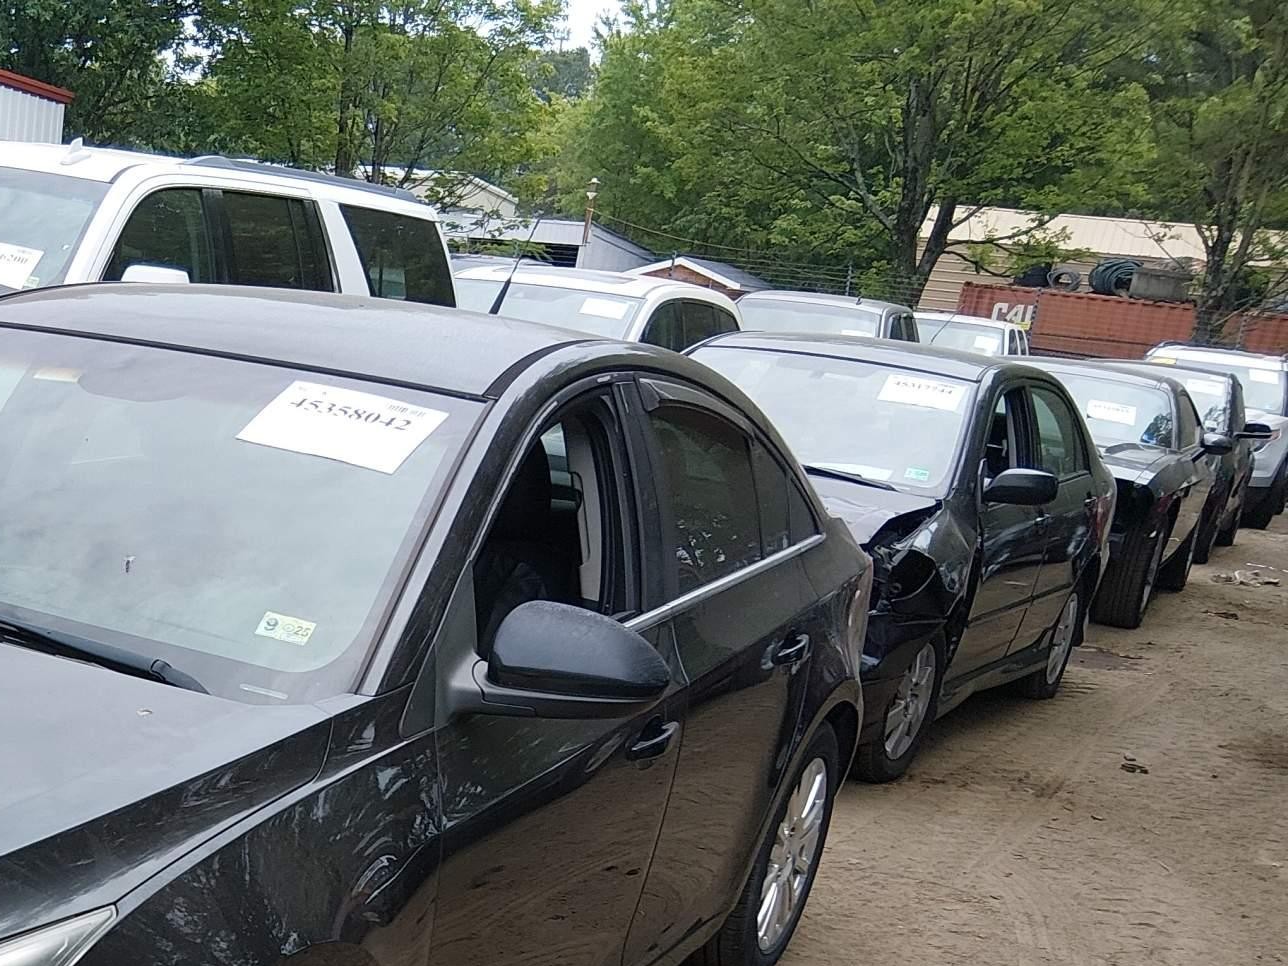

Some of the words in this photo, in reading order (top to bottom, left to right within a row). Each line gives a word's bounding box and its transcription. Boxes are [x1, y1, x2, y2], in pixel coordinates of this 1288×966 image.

[289, 397, 413, 431] 45358042
[263, 617, 279, 632] 9
[294, 625, 312, 638] 25
